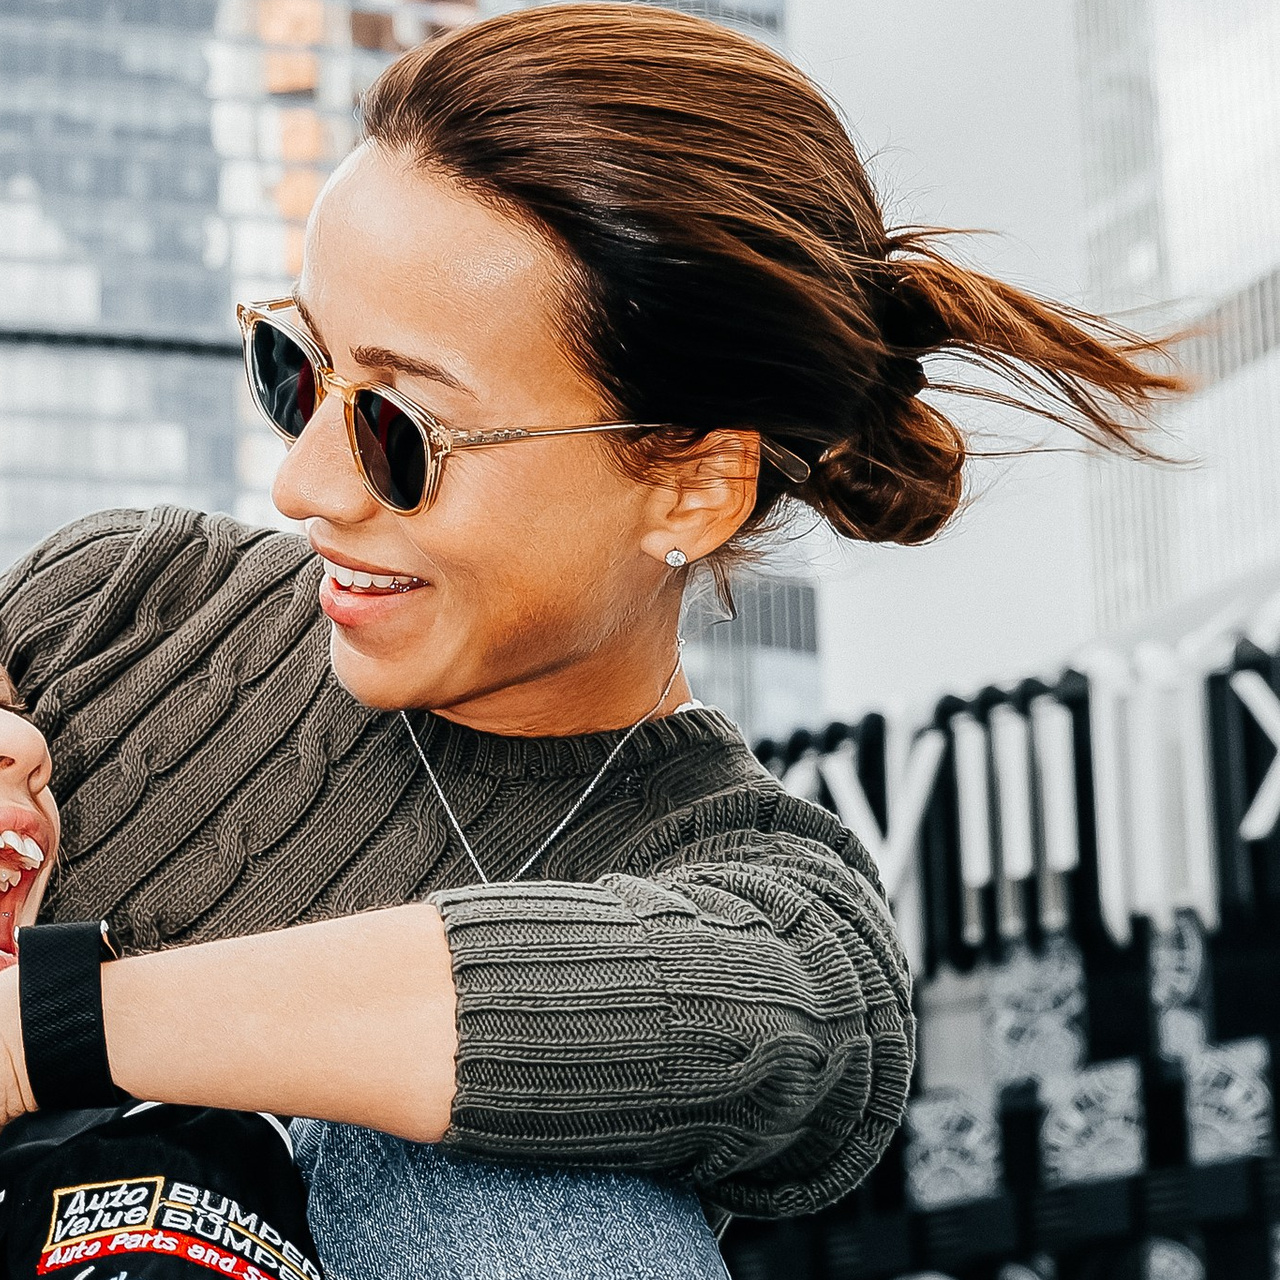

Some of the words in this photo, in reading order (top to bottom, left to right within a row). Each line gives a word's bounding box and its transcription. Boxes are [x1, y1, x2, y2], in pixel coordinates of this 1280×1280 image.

[63, 1183, 149, 1219] Auto
[54, 1205, 149, 1242] Value
[45, 1240, 100, 1268] Auto
[108, 1231, 179, 1251] Parts
[186, 1244, 238, 1272] and
